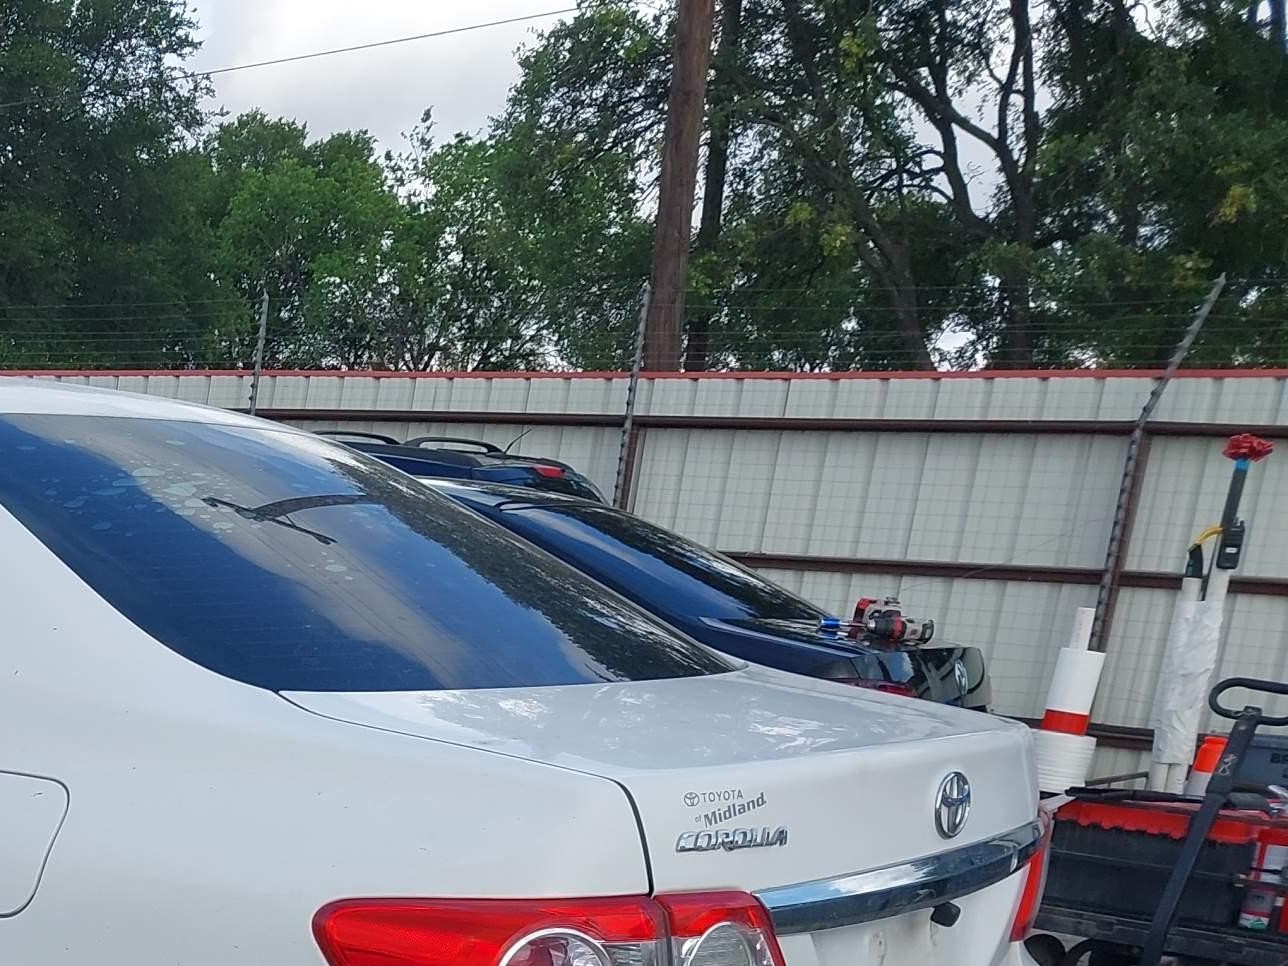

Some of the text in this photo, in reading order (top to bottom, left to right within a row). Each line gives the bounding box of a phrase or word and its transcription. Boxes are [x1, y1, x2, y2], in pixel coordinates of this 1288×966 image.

[701, 789, 744, 802] TOYOTA
[703, 791, 767, 828] Midland
[675, 826, 789, 853] COROLLA
